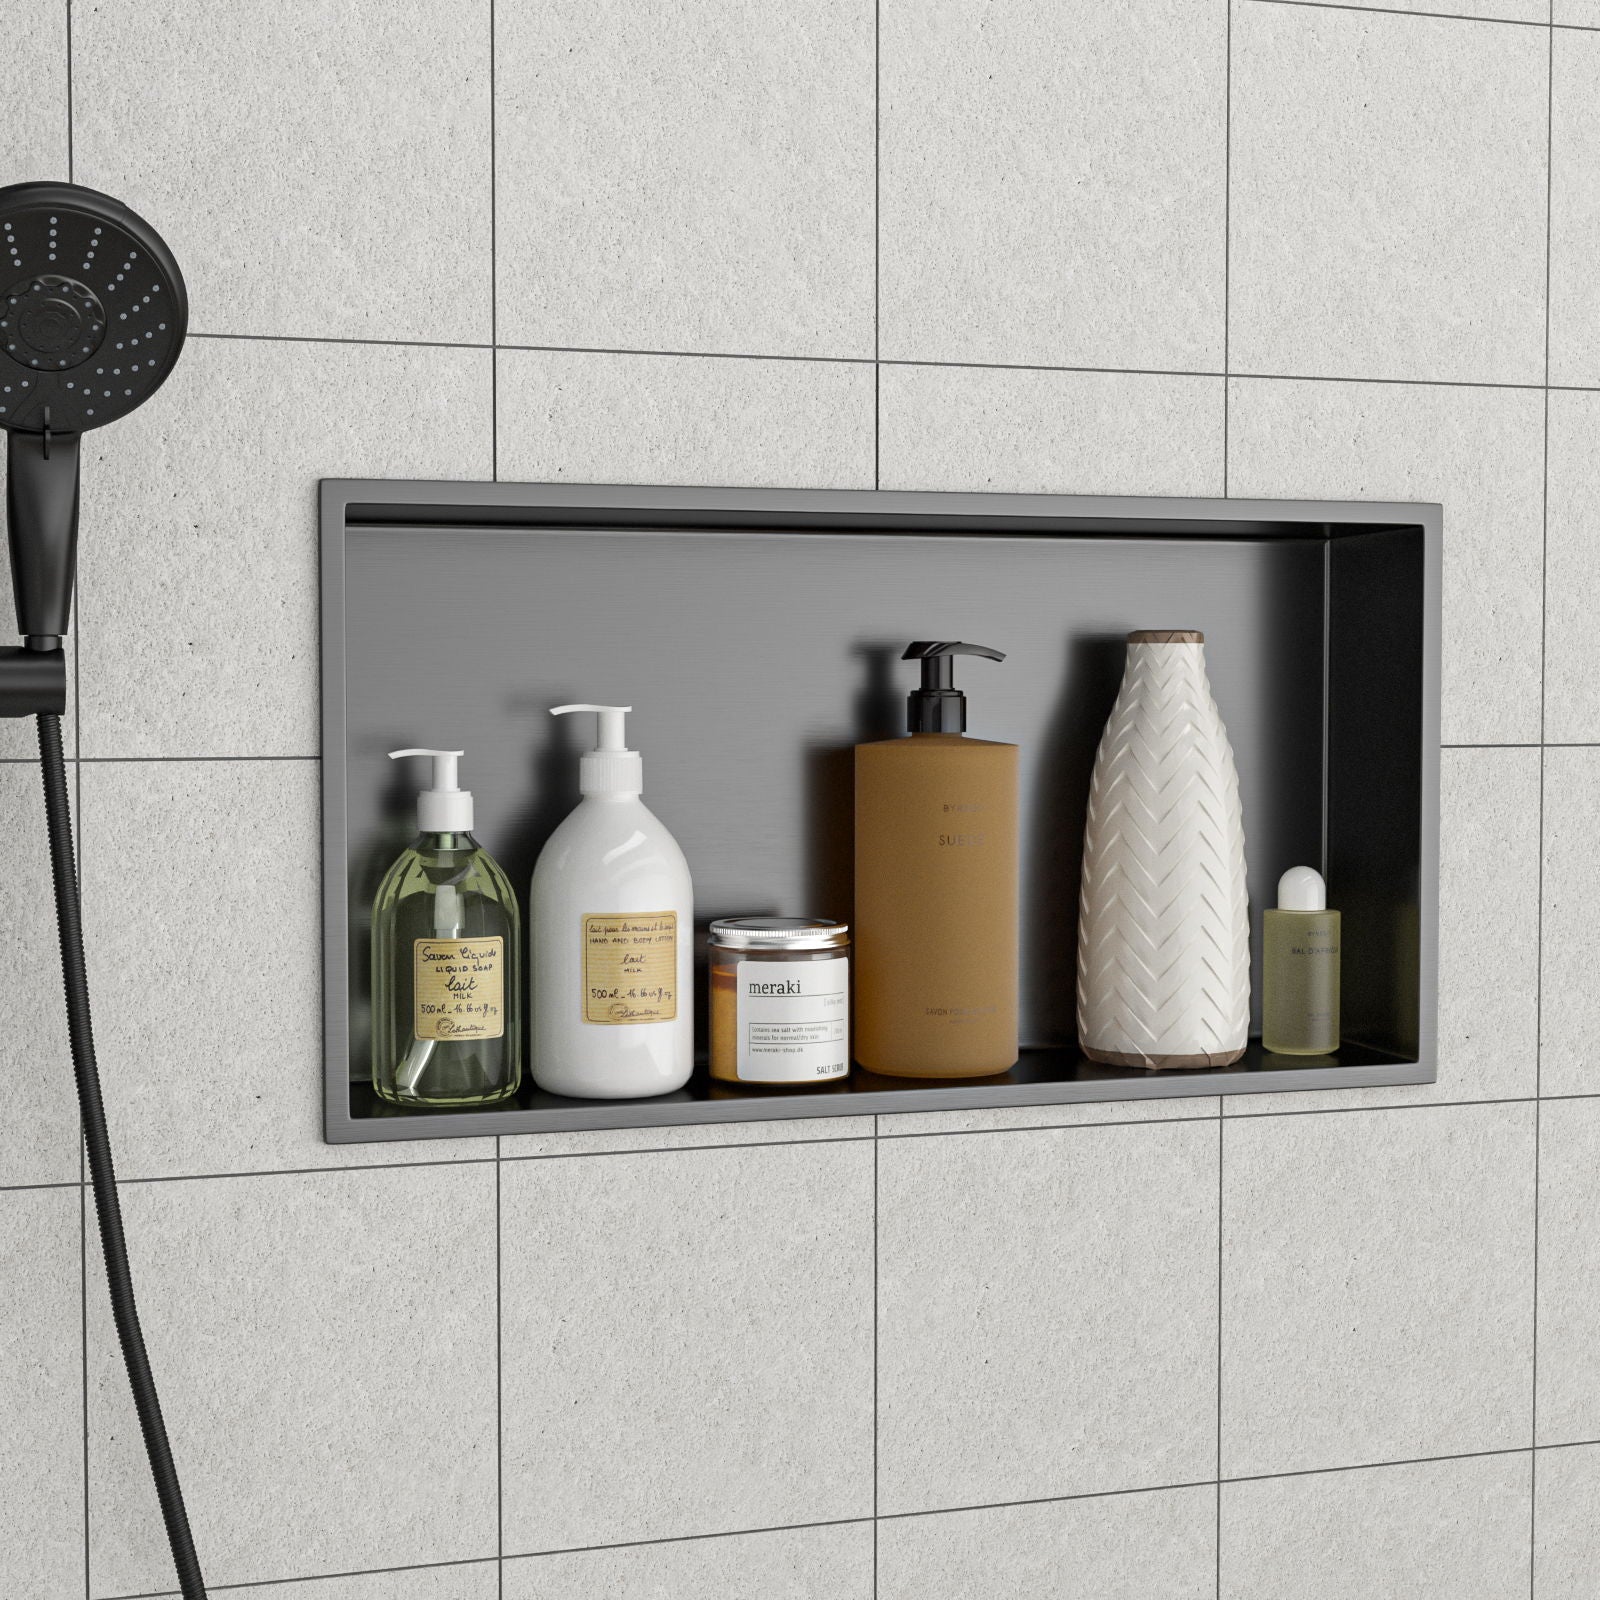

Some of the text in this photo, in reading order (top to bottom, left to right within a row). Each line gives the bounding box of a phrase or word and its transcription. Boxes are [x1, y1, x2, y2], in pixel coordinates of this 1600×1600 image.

[422, 946, 455, 962] Savon
[435, 964, 493, 974] LIQUID SOAP
[444, 975, 478, 991] lait
[748, 979, 801, 994] meraki
[816, 1065, 831, 1075] SALT
